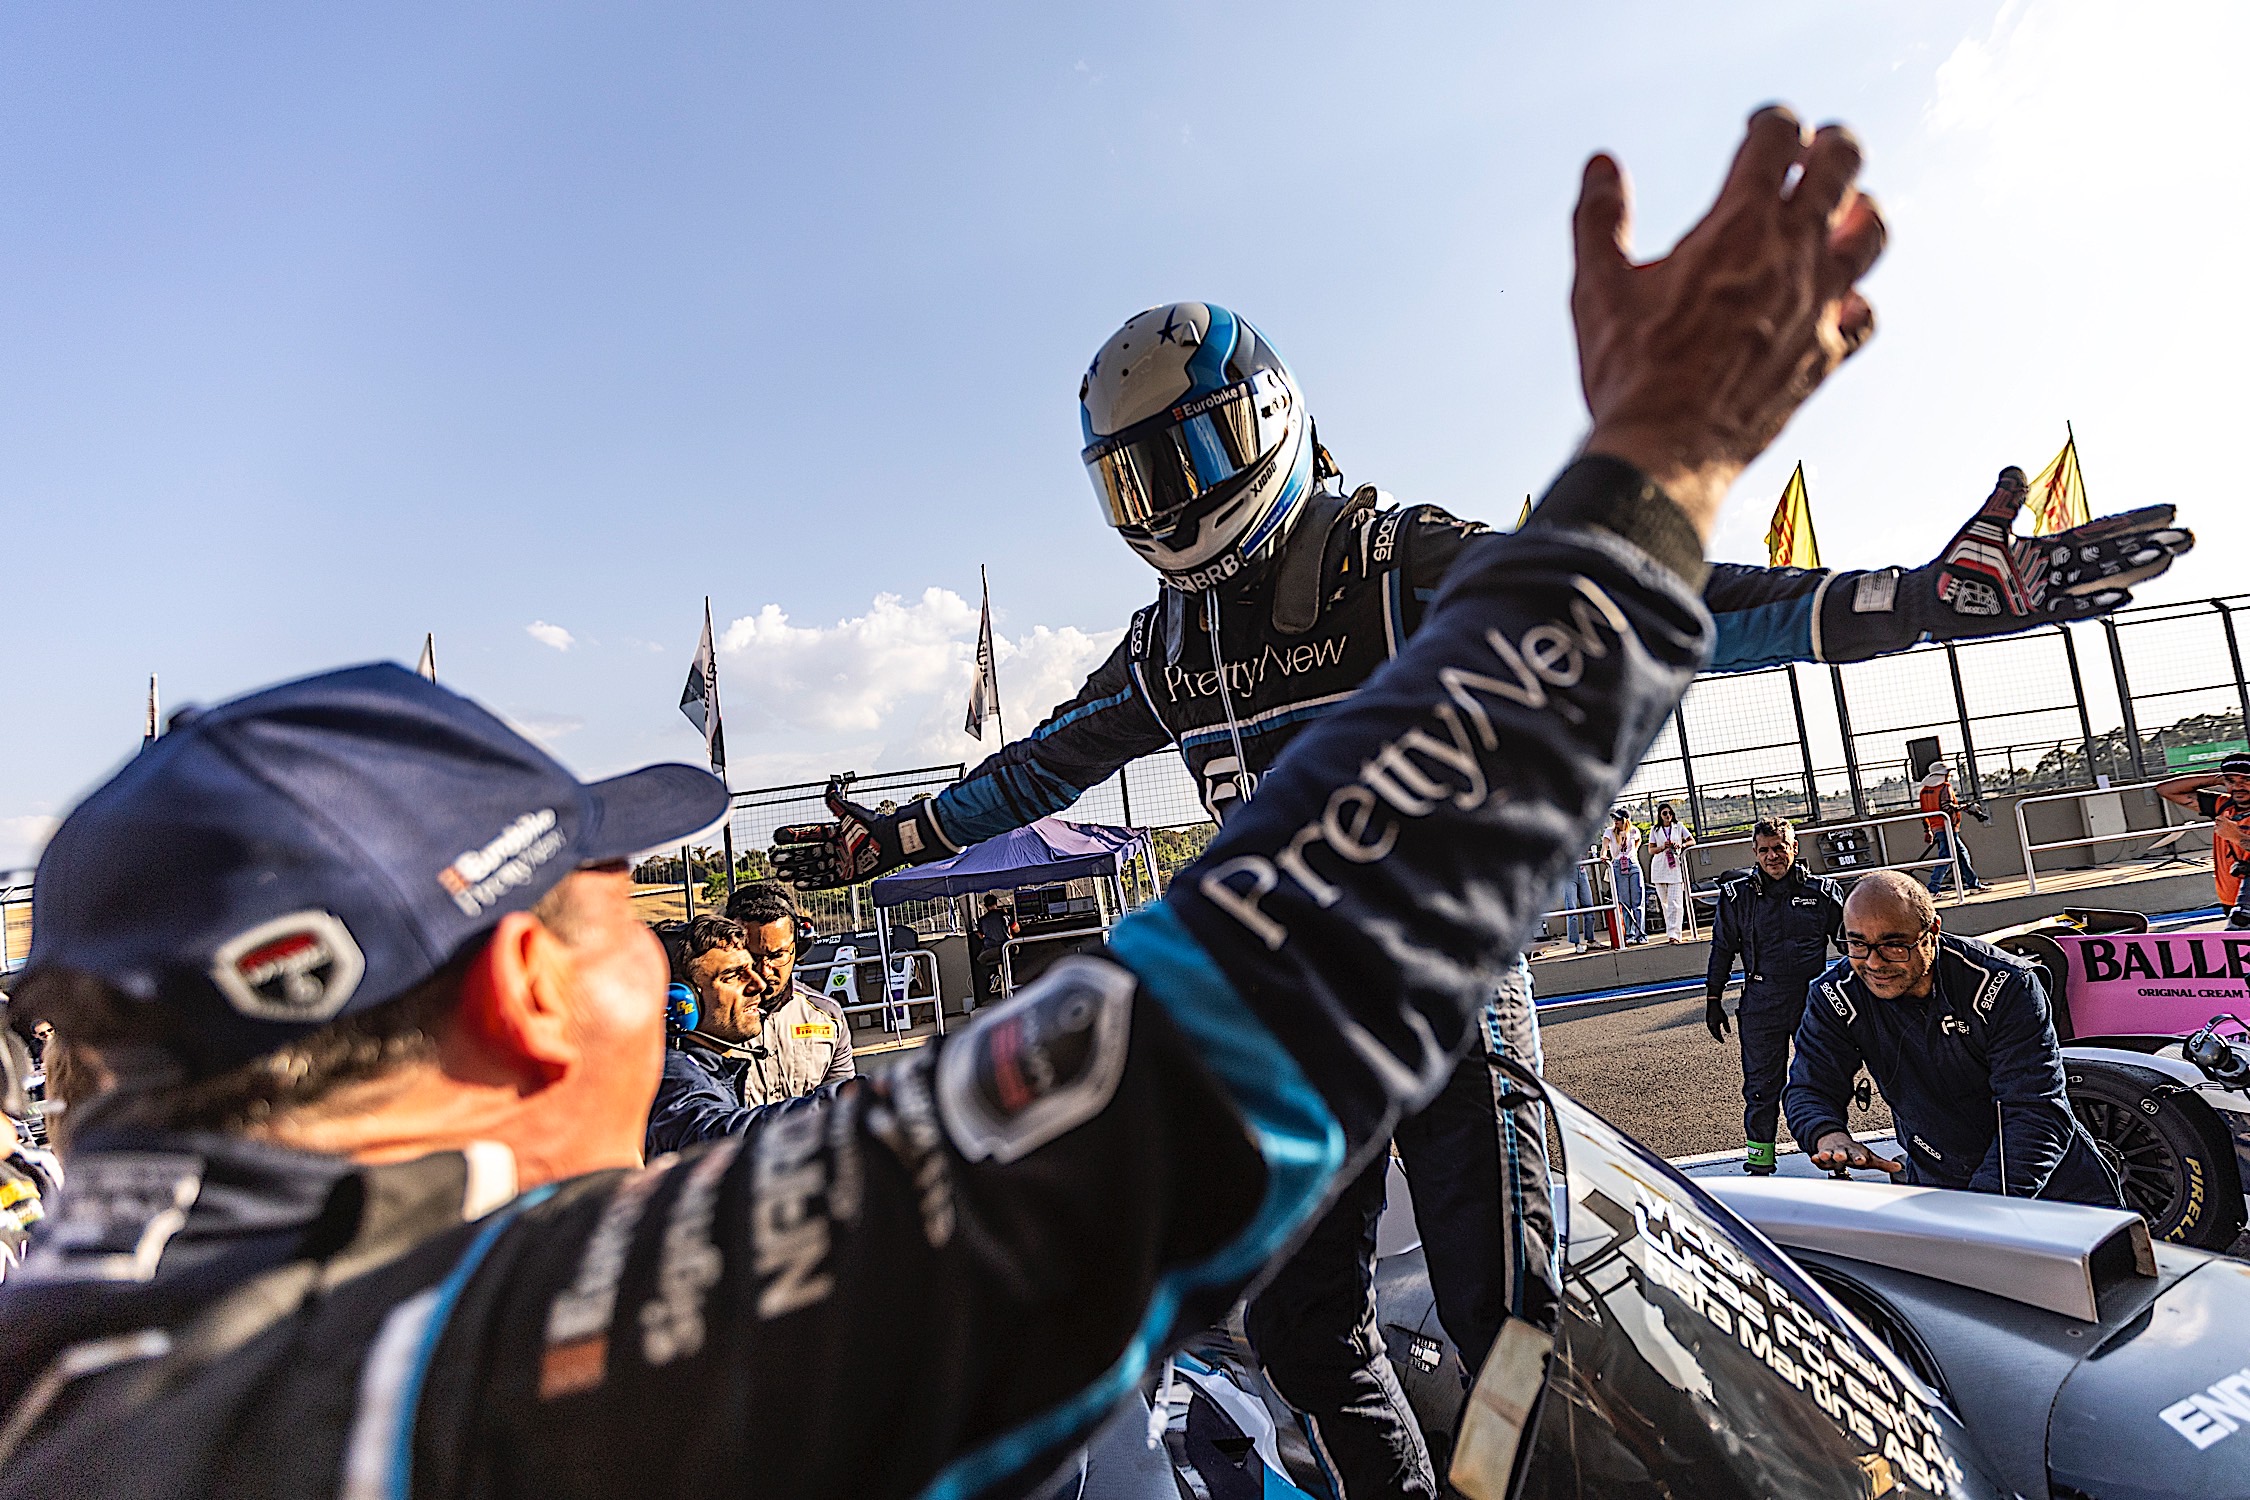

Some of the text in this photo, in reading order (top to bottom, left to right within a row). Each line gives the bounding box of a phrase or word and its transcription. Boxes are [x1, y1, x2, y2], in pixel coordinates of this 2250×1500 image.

[1182, 388, 1238, 417] Eurobike
[1191, 554, 1239, 590] BRB
[1838, 854, 1857, 866] BOX
[1820, 981, 1848, 1017] sparco
[1981, 970, 2010, 1011] sparco
[2137, 988, 2196, 998] ORIGINAL
[2197, 989, 2244, 998] CREAM
[1634, 1203, 1768, 1331] Lucas
[1773, 1313, 1917, 1449] Foresti
[1764, 1277, 1899, 1403] Foresti
[1644, 1245, 1946, 1496] Rafa Martins AB+
